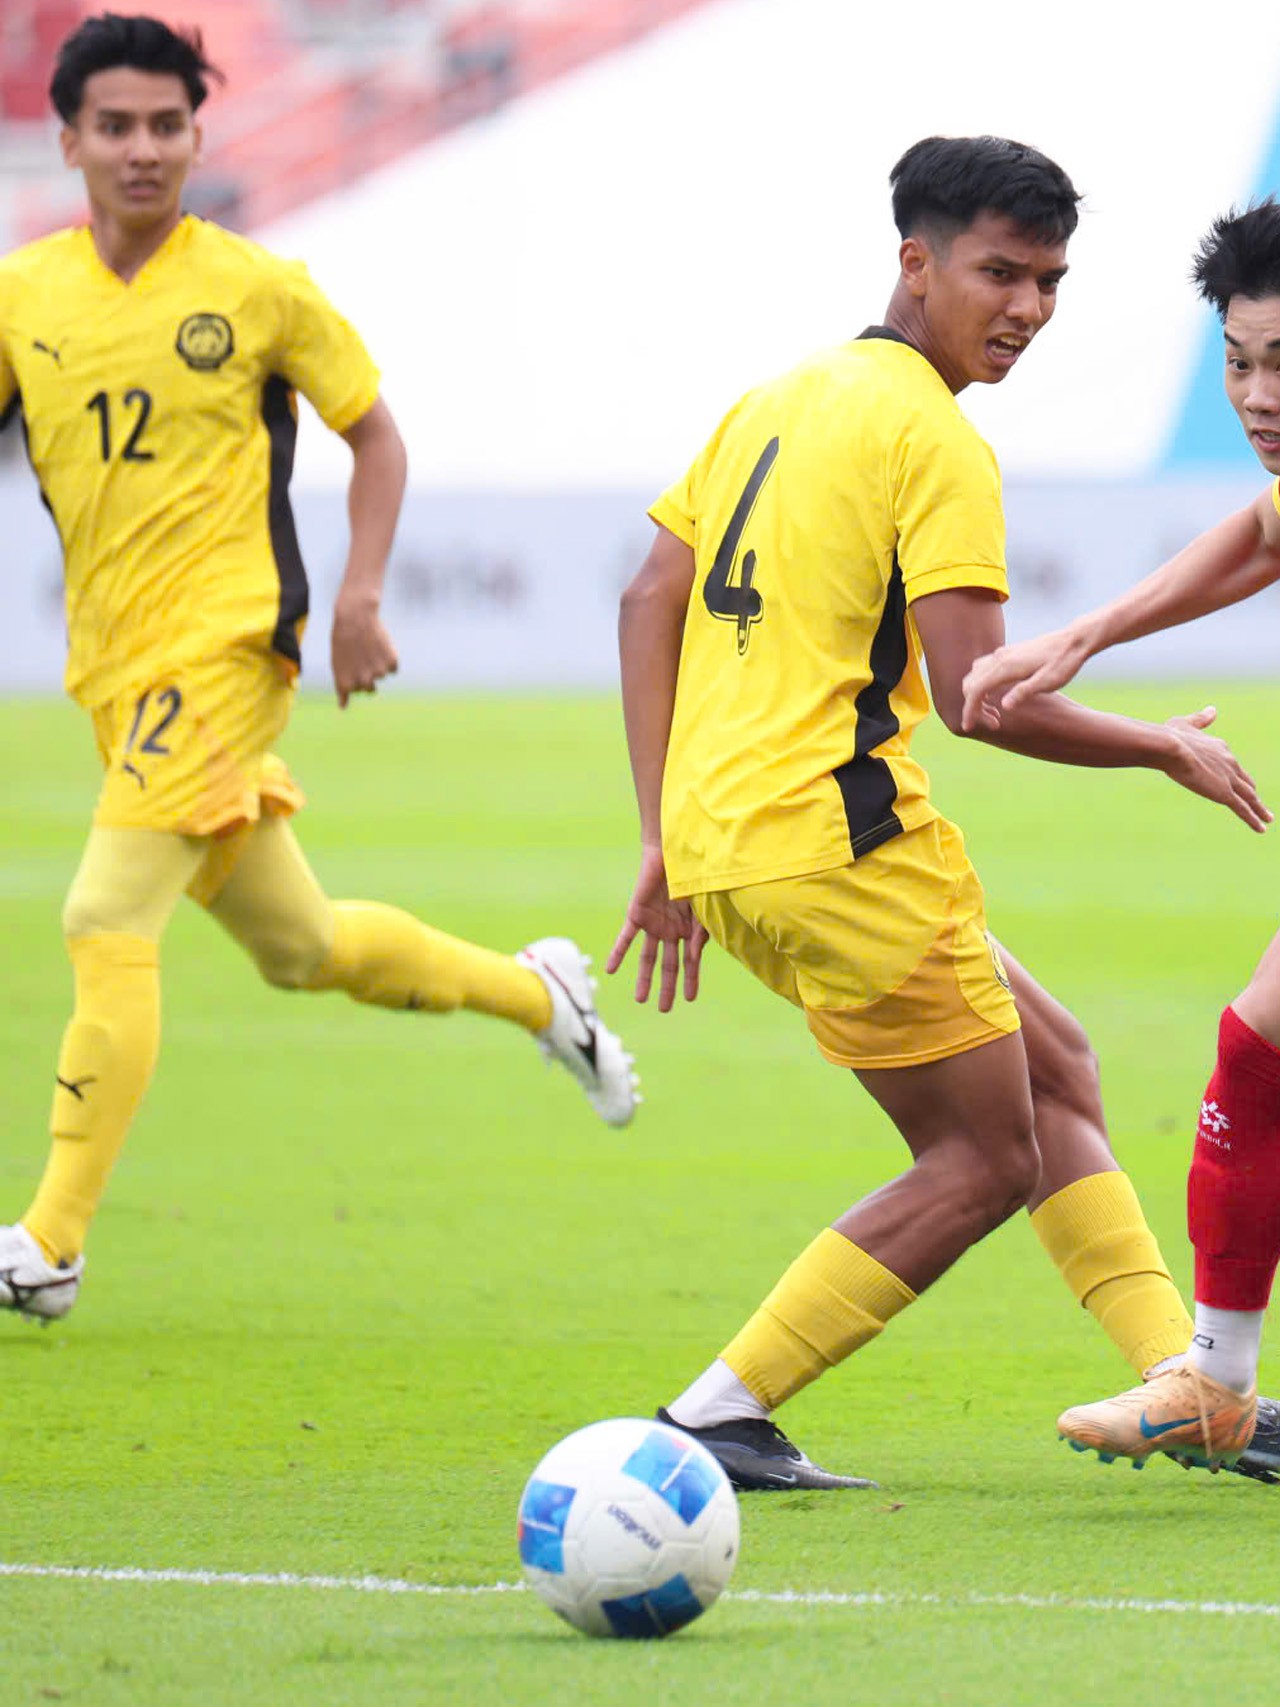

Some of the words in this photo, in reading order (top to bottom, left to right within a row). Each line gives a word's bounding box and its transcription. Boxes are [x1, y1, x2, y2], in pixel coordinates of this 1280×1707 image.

[87, 389, 154, 462] 12
[703, 436, 780, 656] 4
[124, 684, 183, 754] 12
